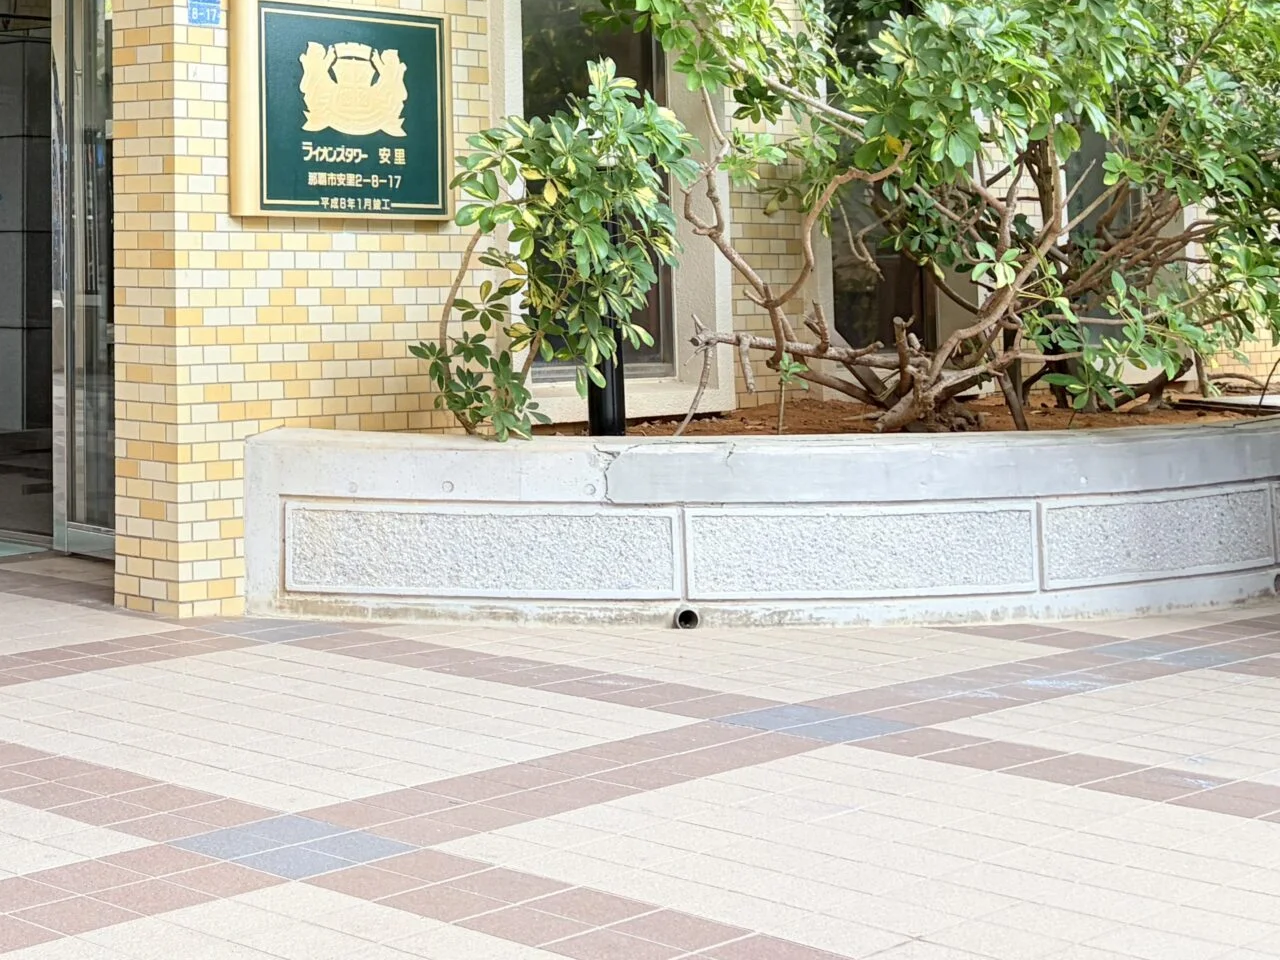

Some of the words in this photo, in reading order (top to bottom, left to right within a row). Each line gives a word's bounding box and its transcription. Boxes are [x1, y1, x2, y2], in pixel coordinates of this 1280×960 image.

[191, 7, 217, 22] 8-17
[301, 141, 369, 164] ライオンズタワー
[320, 196, 391, 211] 平成8年1月竣工
